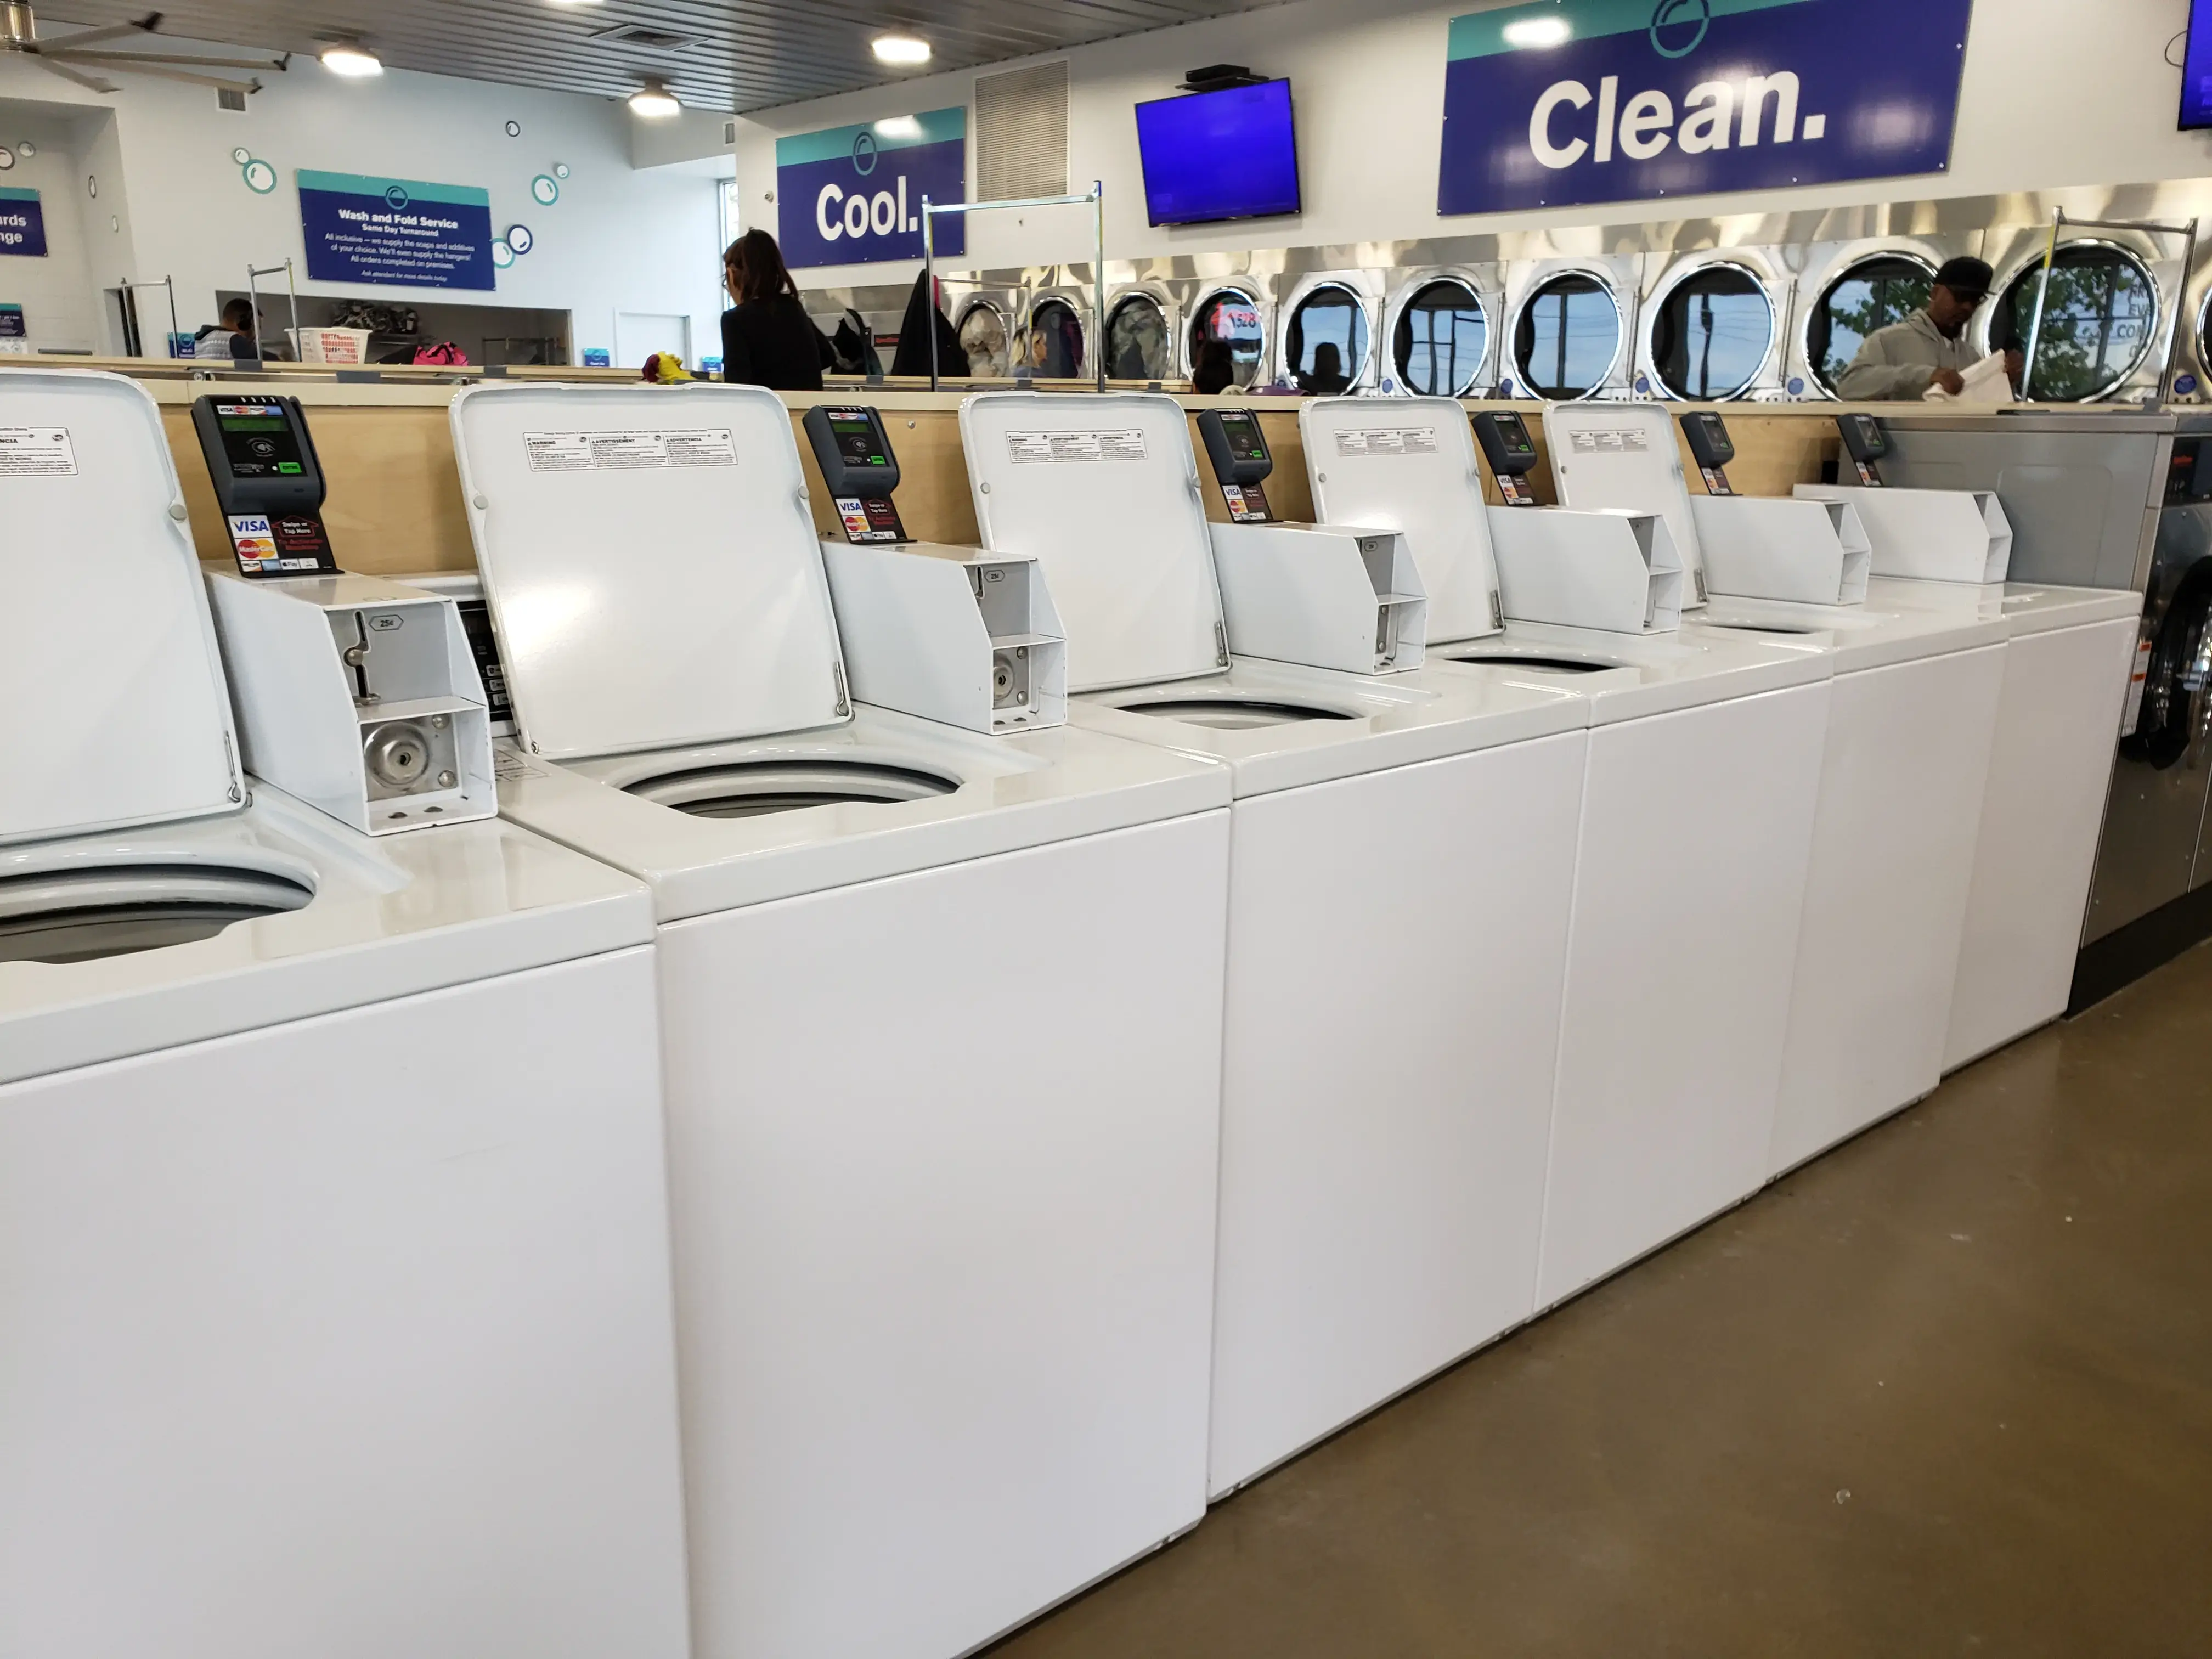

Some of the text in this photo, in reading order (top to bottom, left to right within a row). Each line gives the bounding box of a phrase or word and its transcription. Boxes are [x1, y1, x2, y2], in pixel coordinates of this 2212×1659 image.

[1529, 70, 1826, 169] Clean.
[816, 176, 918, 241] Cool.
[338, 209, 459, 229] Wash and Fold Service
[362, 223, 439, 236] Same Day Turnaround
[335, 234, 363, 242] inclusive
[383, 239, 403, 248] supply
[449, 243, 475, 252] additives
[350, 254, 360, 262] All
[360, 256, 382, 264] orders
[382, 258, 416, 267] completed
[413, 251, 433, 259] supply
[840, 502, 862, 511] VISA
[234, 521, 269, 532] VISA
